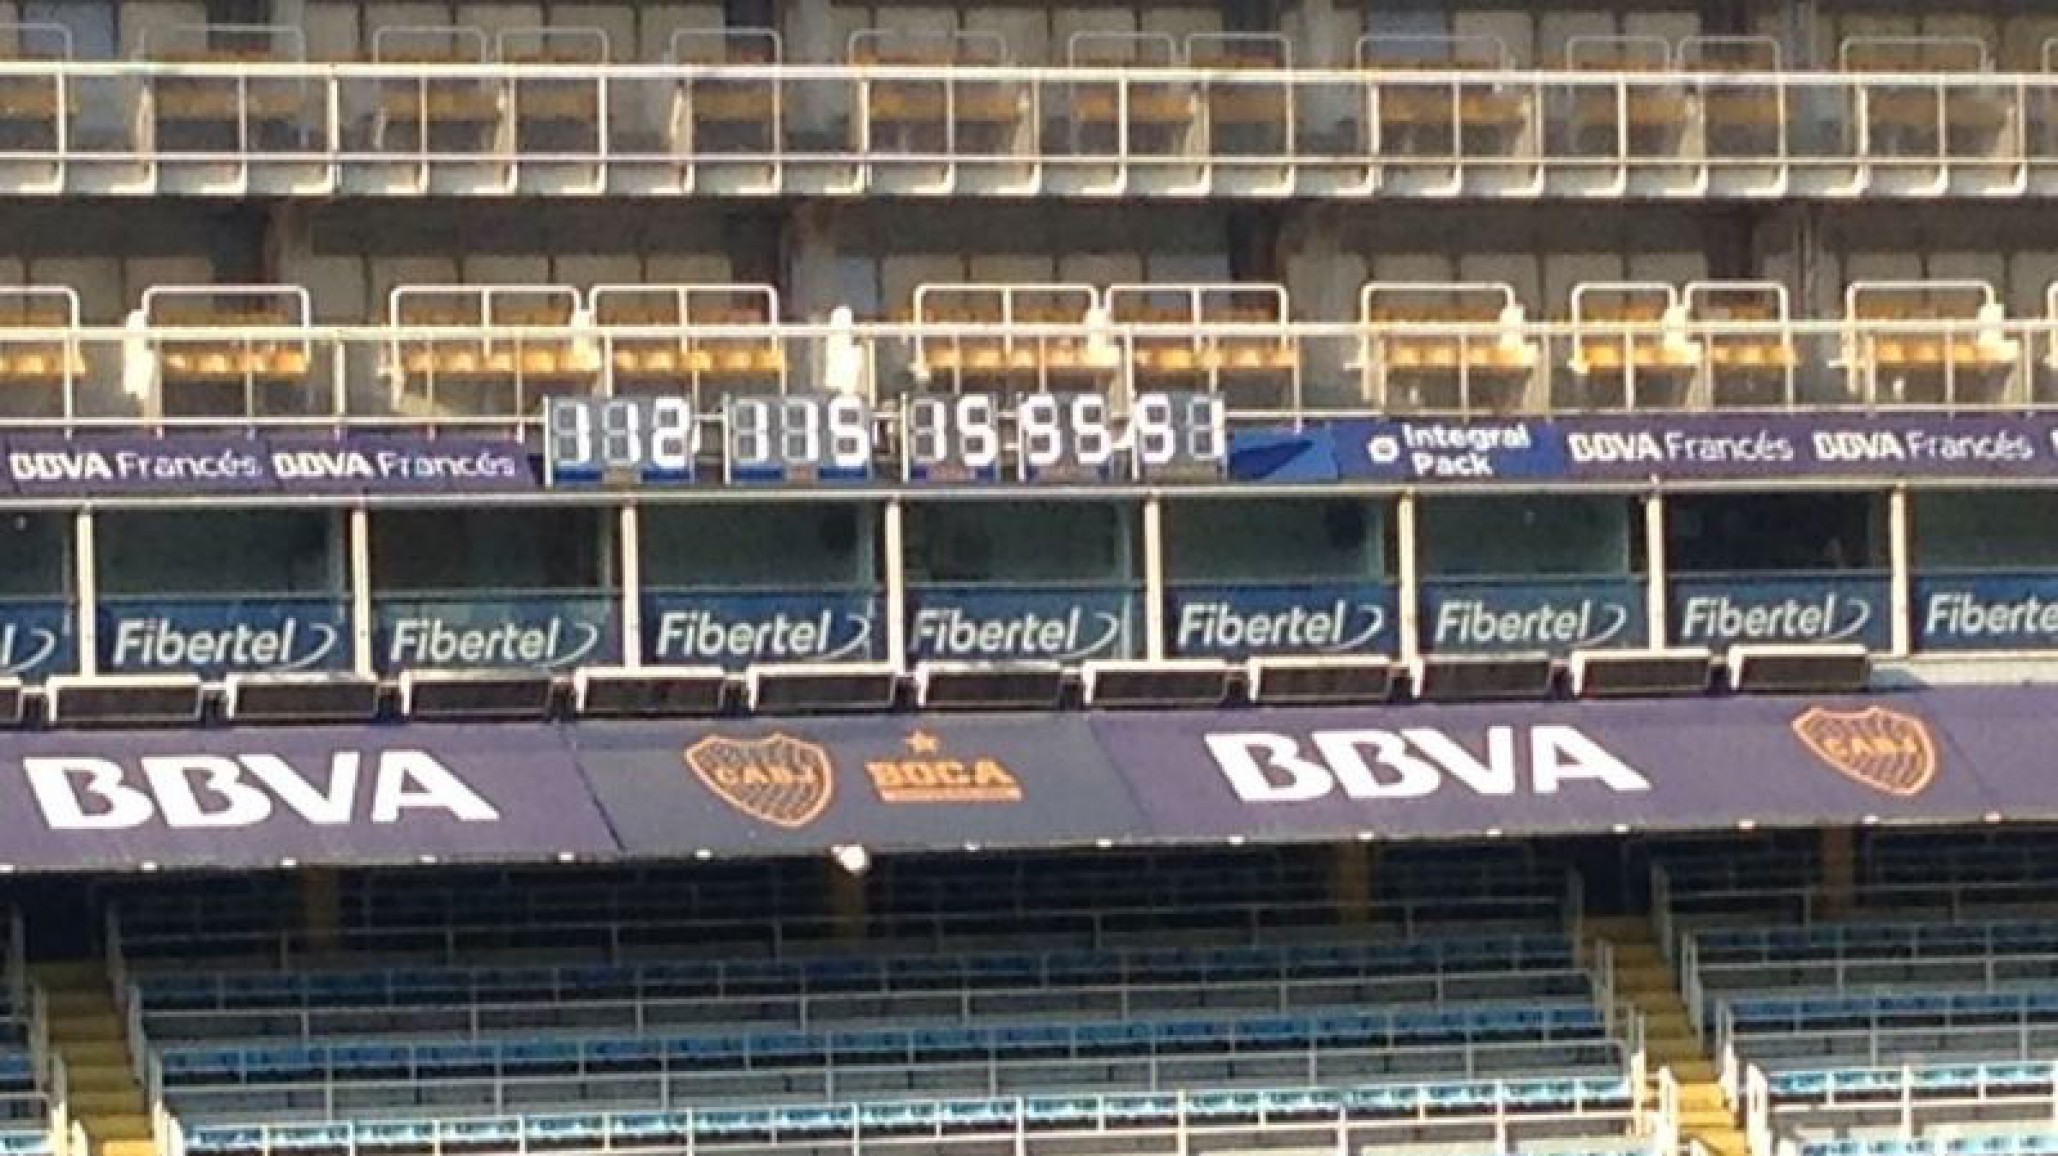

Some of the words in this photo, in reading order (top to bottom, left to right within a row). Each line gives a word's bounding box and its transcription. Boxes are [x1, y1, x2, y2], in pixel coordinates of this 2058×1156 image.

[1402, 423, 1532, 451] Integral
[1411, 452, 1494, 476] Pack
[656, 609, 834, 657] Fibertel
[911, 608, 1079, 653] Fibertel
[1178, 599, 1346, 648] Fibertel
[1434, 600, 1590, 643] Fibertel
[1681, 592, 1838, 639] Fibertel
[113, 617, 296, 664] Fibertel
[390, 618, 562, 662] Fibertel
[865, 759, 1016, 786] BOCA
[1203, 725, 1652, 802] BBVA
[22, 751, 500, 829] BBVA
